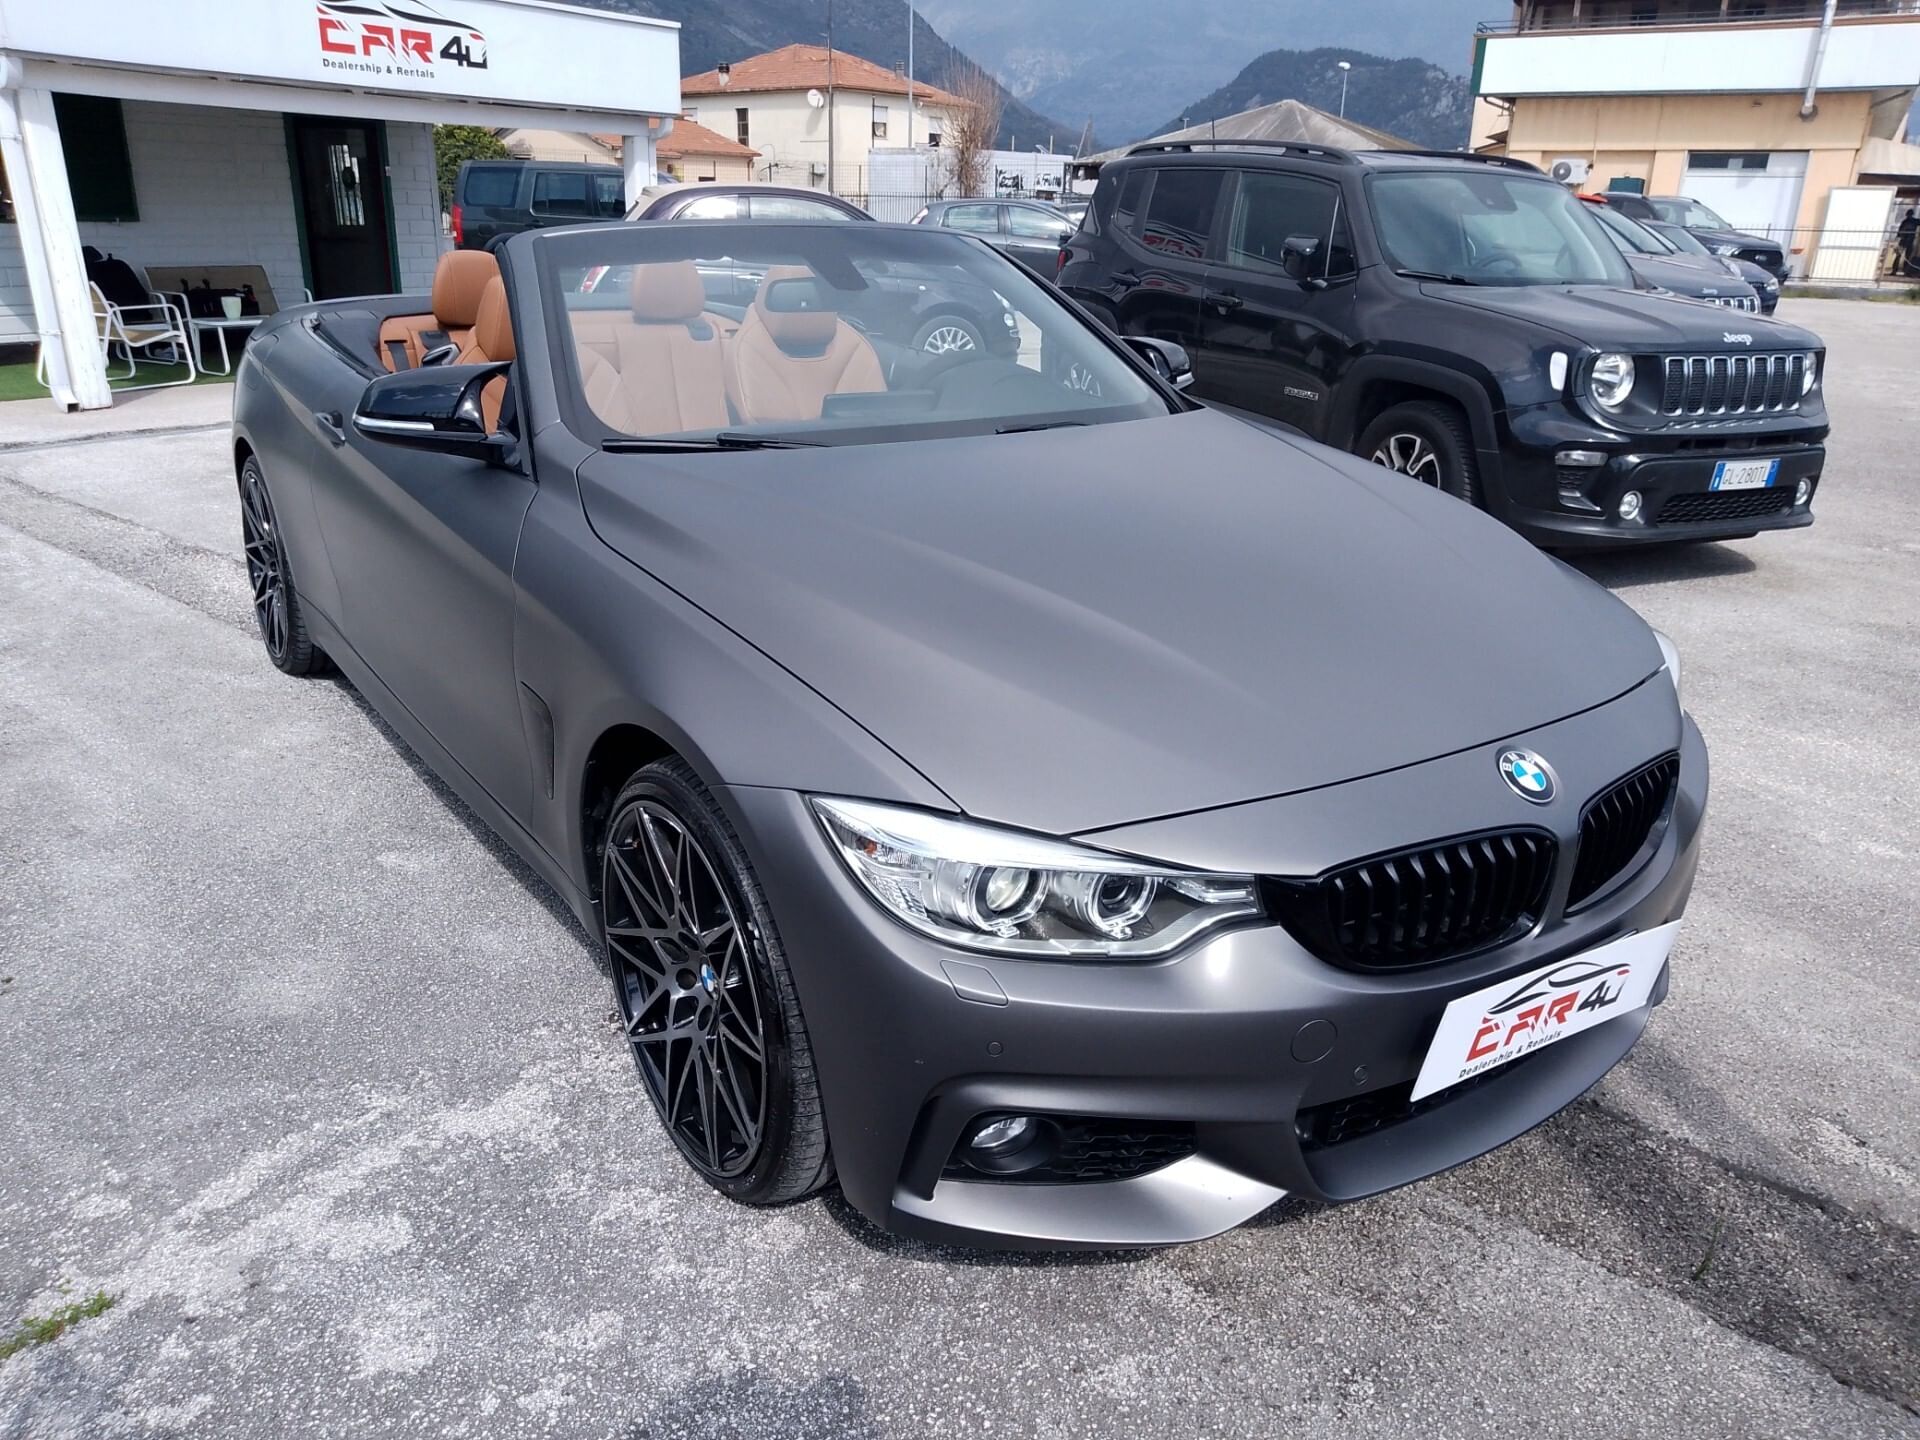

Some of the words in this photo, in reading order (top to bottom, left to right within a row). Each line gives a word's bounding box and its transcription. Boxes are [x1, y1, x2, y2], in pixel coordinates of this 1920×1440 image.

[318, 18, 434, 64] CAR
[322, 58, 382, 75] Dealership
[386, 66, 393, 75] &
[396, 66, 435, 79] Rentals
[1722, 332, 1753, 346] Jeep
[1465, 990, 1580, 1063] CAR
[1458, 1049, 1514, 1079] Dealership
[1516, 1045, 1523, 1054] &
[1525, 1030, 1563, 1052] Rentals
